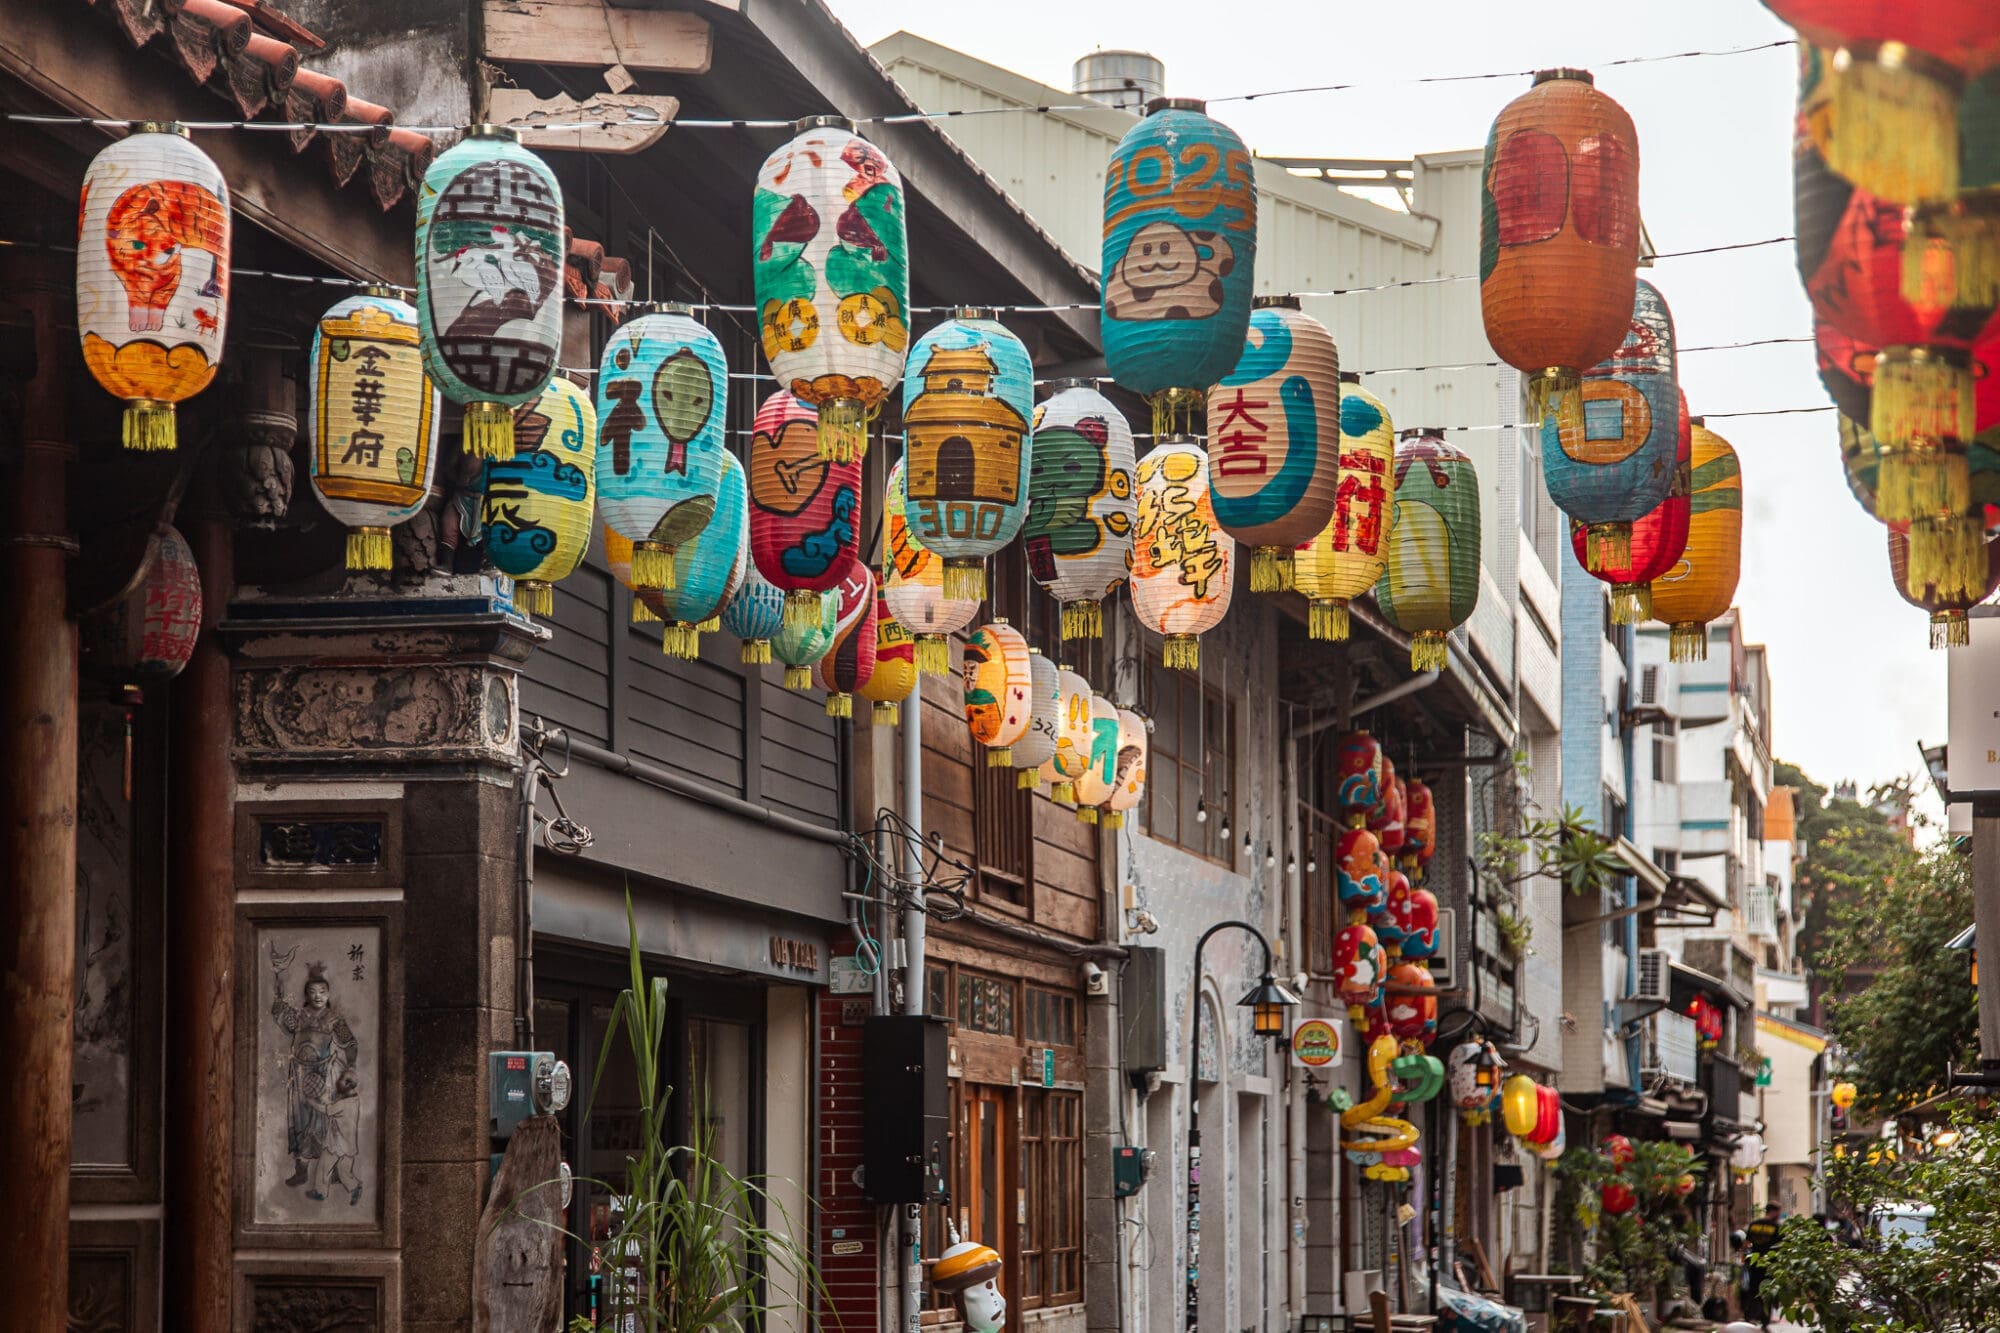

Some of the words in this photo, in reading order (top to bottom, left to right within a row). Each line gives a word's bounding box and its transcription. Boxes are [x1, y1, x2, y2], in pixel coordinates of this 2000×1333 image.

[341, 345, 391, 468] 金華府
[1217, 388, 1269, 477] 大吉
[918, 498, 1004, 540] 300
[848, 972, 870, 990] 73
